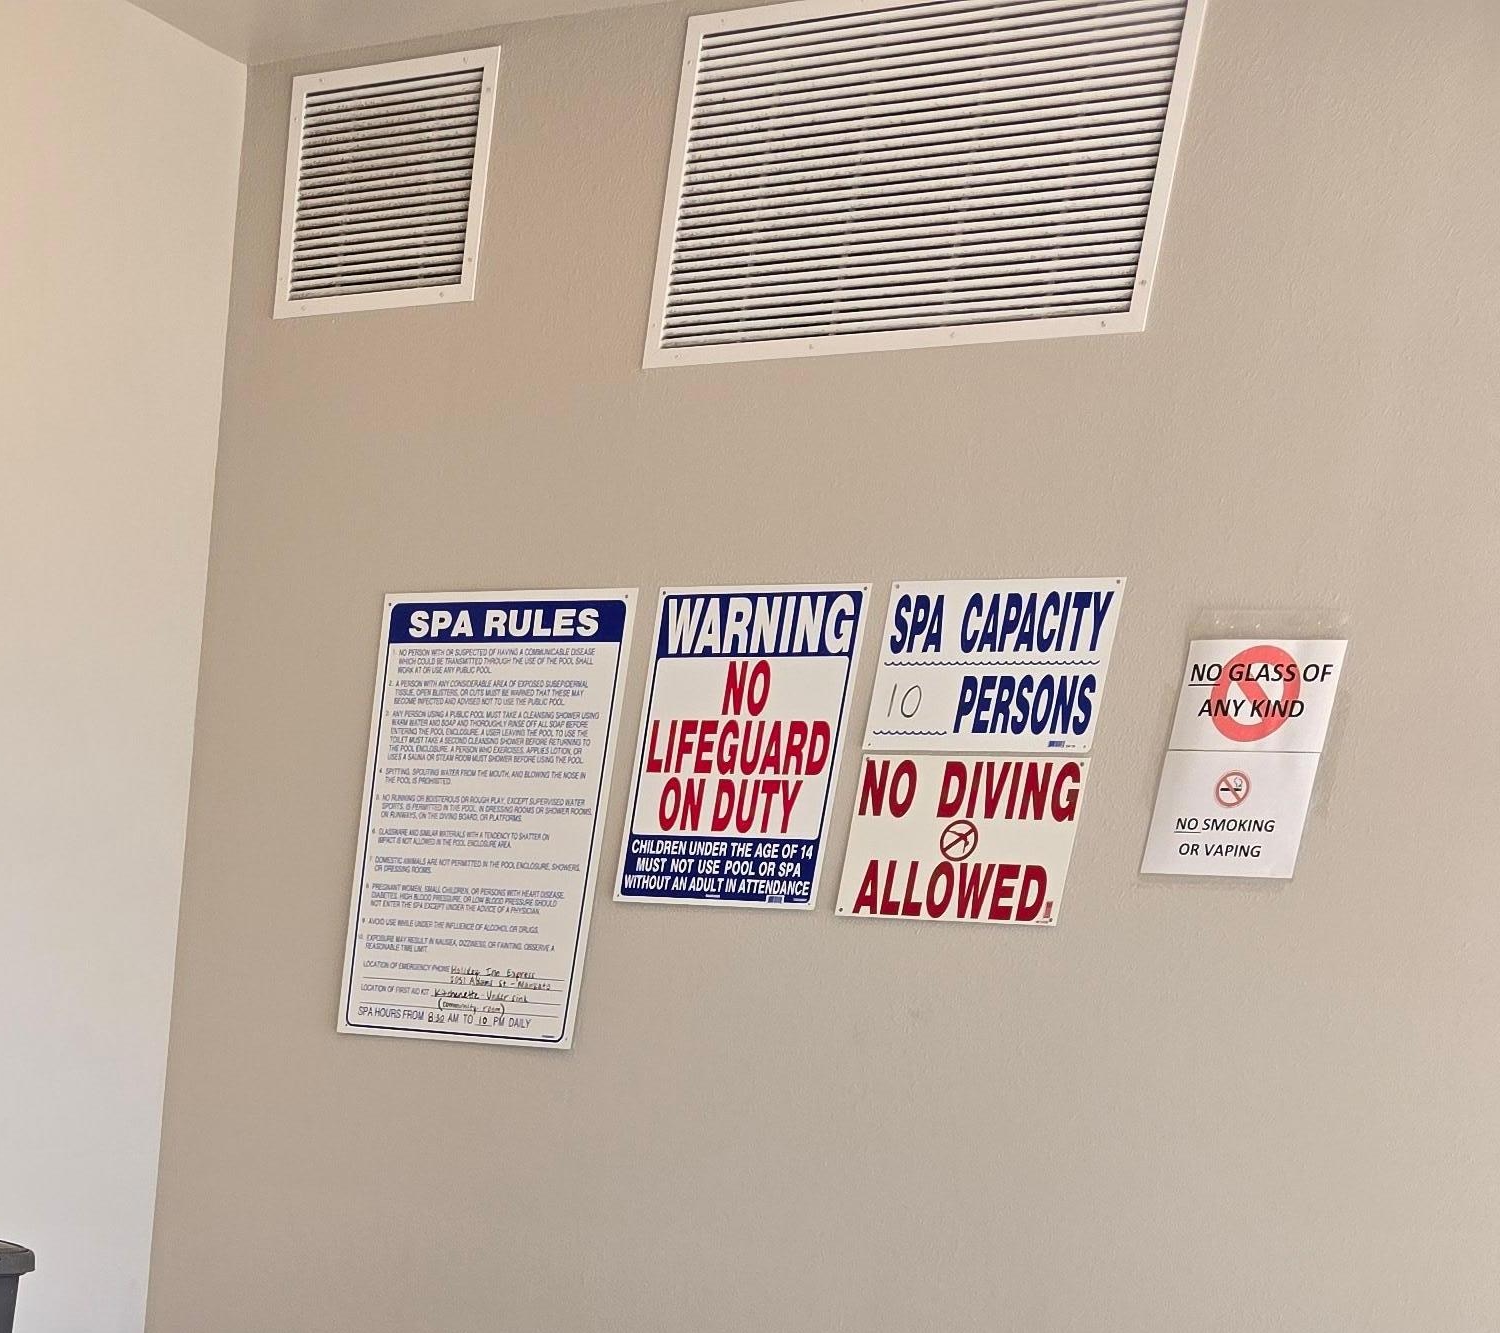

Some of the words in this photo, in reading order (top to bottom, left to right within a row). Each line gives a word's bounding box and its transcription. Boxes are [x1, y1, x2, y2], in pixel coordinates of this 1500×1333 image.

[408, 610, 473, 637] SPA
[484, 608, 599, 637] RULES
[667, 594, 855, 654] WARNING
[890, 594, 945, 654] SPA
[960, 591, 1114, 654] CAPACITY
[1190, 663, 1222, 682] NO
[1228, 663, 1296, 682] GLASS
[1302, 663, 1334, 682] OF
[721, 660, 771, 716] NO
[887, 683, 922, 718] 10
[953, 674, 1096, 735] PERSONS
[1198, 699, 1245, 717] ANY
[1249, 700, 1304, 718] KIND
[646, 720, 831, 775] LIFEGUARD
[858, 759, 917, 818] NO
[936, 760, 1081, 821] DIVING
[658, 777, 705, 832] ON
[711, 778, 803, 834] DUTY
[1175, 817, 1199, 831] NO
[1201, 818, 1275, 833] SMOKING
[632, 839, 687, 855] CHILDREN
[689, 840, 728, 857] UNDER
[730, 842, 752, 858] THE
[754, 843, 779, 859] AGE
[781, 844, 798, 859] OF
[800, 845, 813, 860] 14
[1178, 843, 1199, 857] OR
[1204, 844, 1261, 858] VAPING
[636, 857, 667, 872] MUST
[670, 858, 694, 874] NOT
[697, 860, 720, 875] USE
[724, 861, 755, 876] POOL
[758, 862, 775, 876] OR
[777, 862, 801, 877] SPA
[624, 874, 671, 890] WITHOUT
[671, 876, 687, 891] AN
[689, 877, 723, 893] ADULT
[725, 879, 736, 893] IN
[738, 879, 810, 896] ATTENDANCE
[852, 859, 1048, 922] ALLOWED
[358, 1006, 373, 1017] SPA
[374, 1008, 402, 1019] HOURS
[403, 1009, 425, 1020] FROM
[448, 1013, 460, 1023] AM
[463, 1014, 474, 1024] TO
[493, 1017, 506, 1027] PM
[509, 1017, 532, 1029] DAILY
